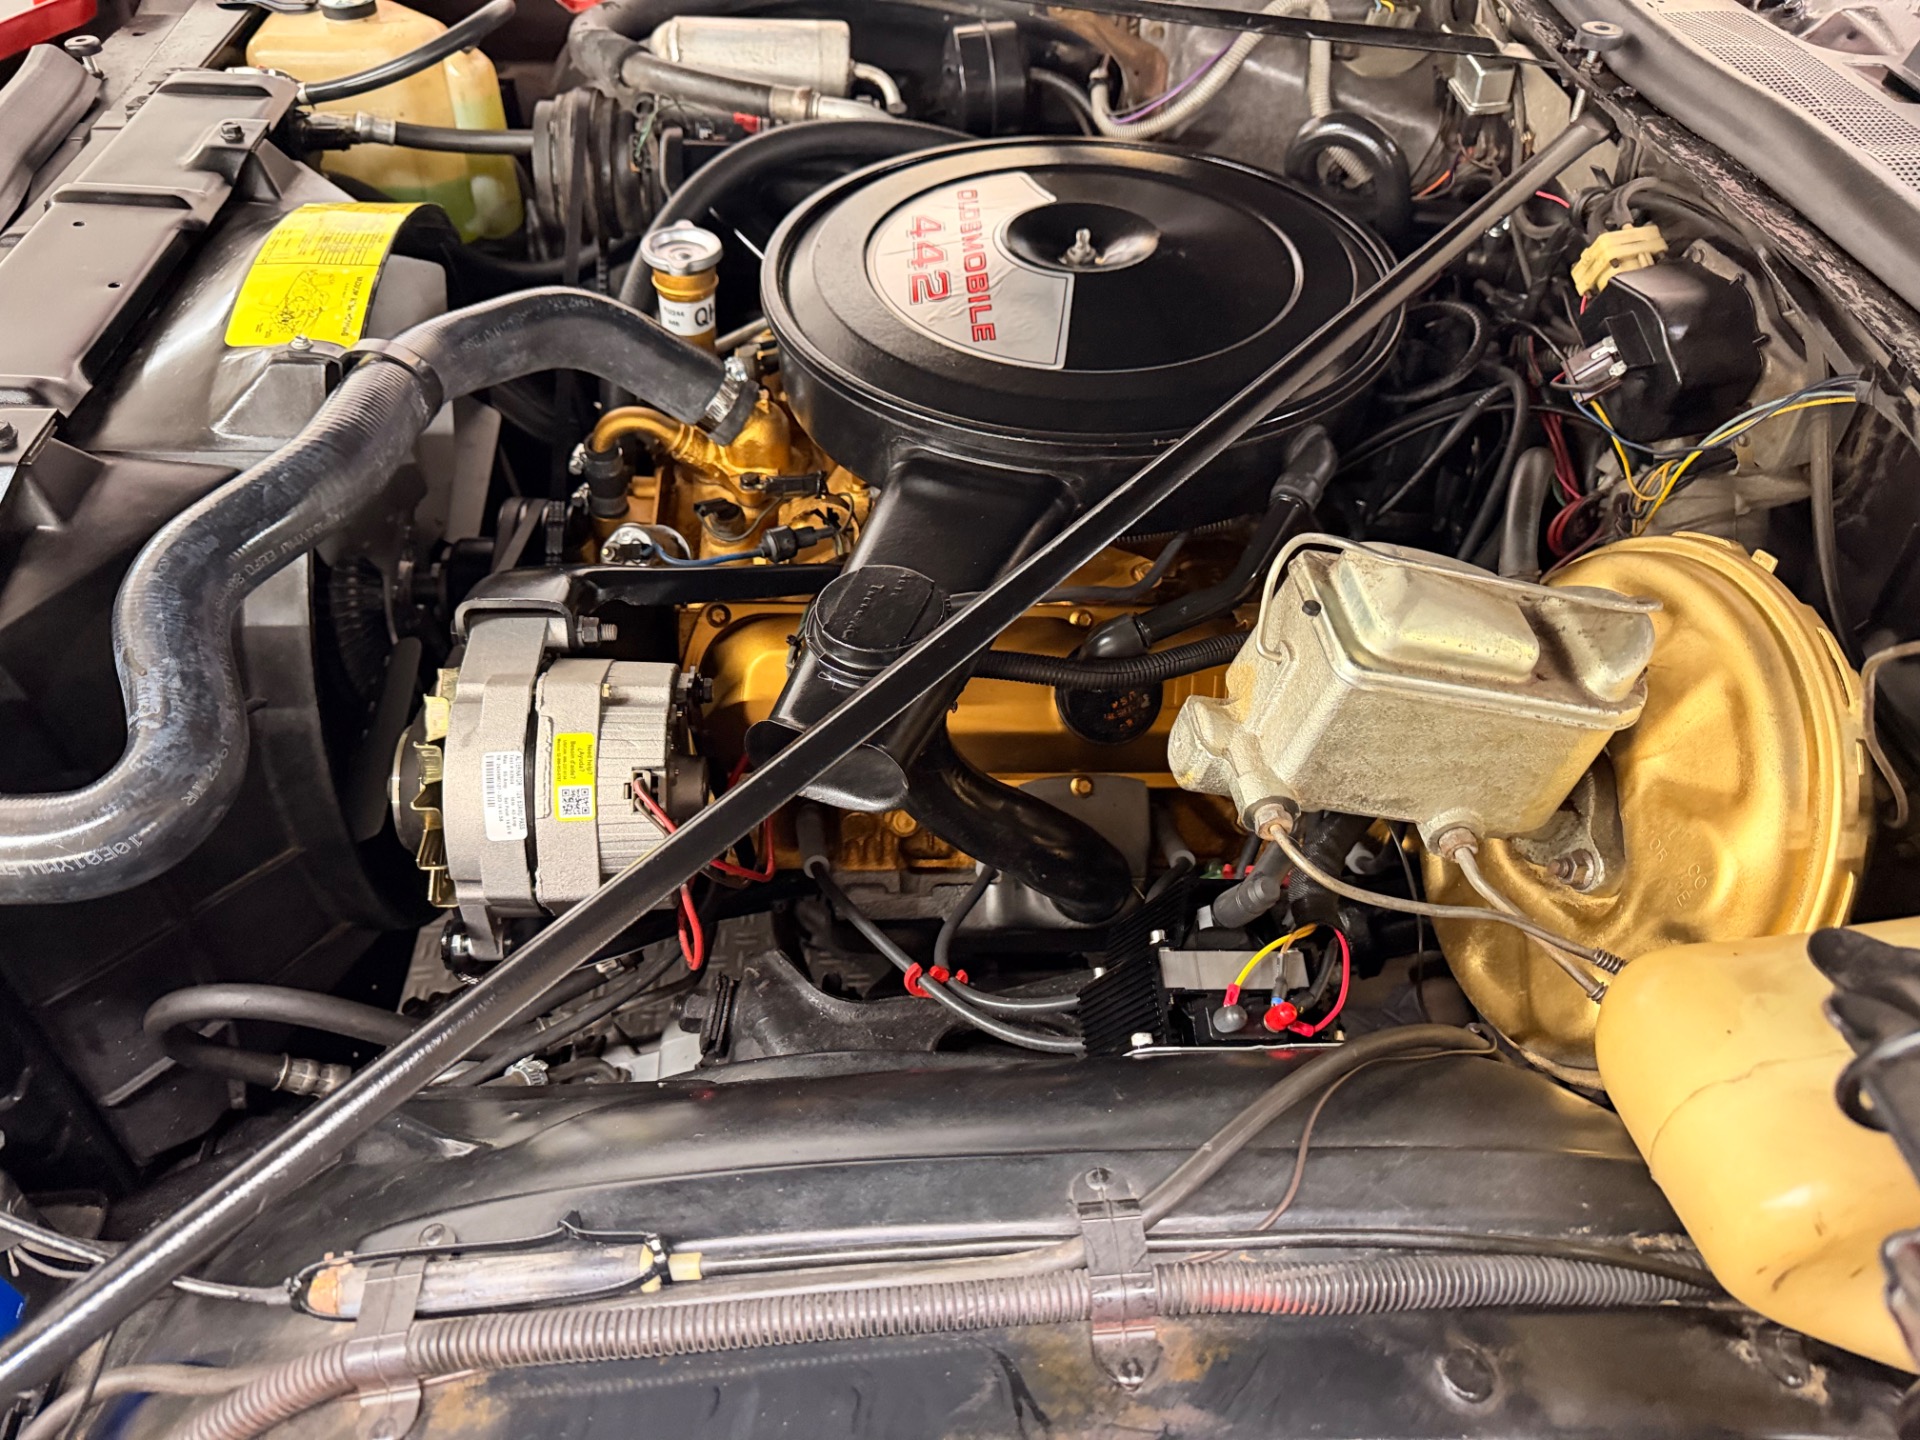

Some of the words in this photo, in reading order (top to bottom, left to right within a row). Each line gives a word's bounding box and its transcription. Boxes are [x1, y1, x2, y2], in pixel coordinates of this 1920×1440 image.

[909, 213, 951, 305] 442
[956, 188, 996, 343] OLDSMOBILE
[515, 755, 523, 786] ALTERNATOR
[577, 748, 585, 772] ¿Ayuda?
[518, 817, 526, 830] PASS
